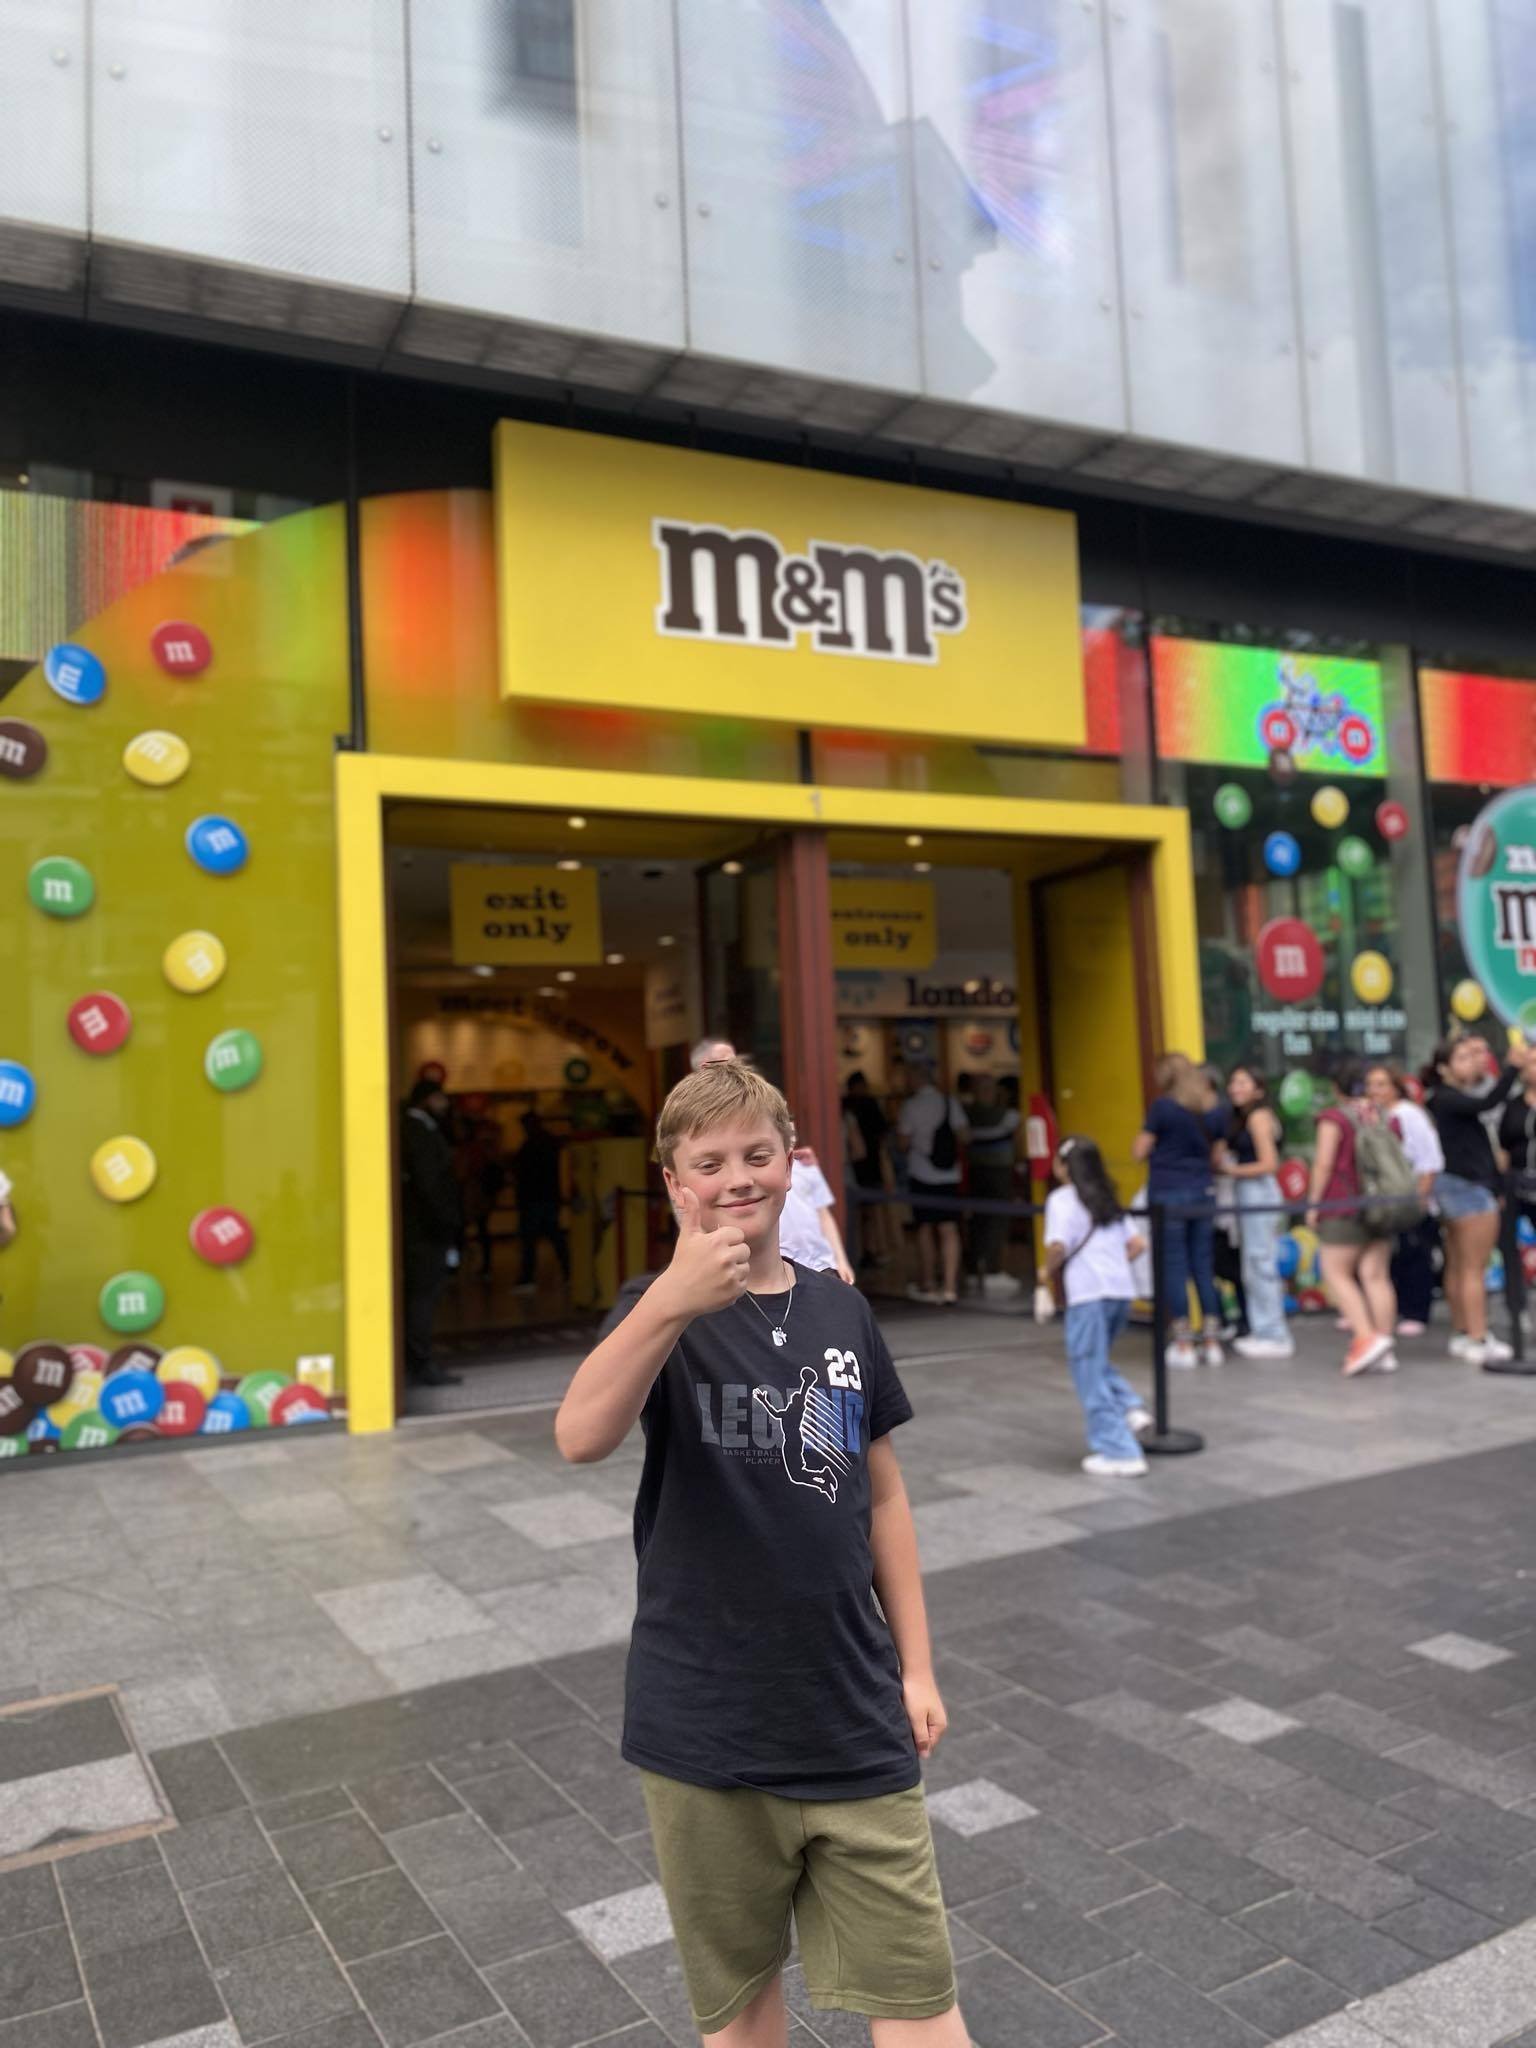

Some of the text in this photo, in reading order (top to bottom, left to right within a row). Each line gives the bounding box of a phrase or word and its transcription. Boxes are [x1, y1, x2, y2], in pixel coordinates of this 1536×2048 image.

[165, 641, 195, 664] m
[140, 740, 168, 762] m
[206, 826, 238, 852] m
[44, 879, 73, 902] m
[484, 886, 568, 911] exit
[483, 917, 572, 943] only
[844, 926, 911, 950] only
[1275, 946, 1307, 976] m
[214, 1045, 240, 1070] m
[118, 1292, 146, 1315] m
[35, 1360, 63, 1385] m
[823, 1347, 862, 1391] 23
[113, 1391, 147, 1417] m
[204, 1409, 232, 1432] m
[696, 1383, 864, 1455] LEGND
[722, 1448, 781, 1457] BASKETBALL
[745, 1457, 781, 1465] PLAYER
